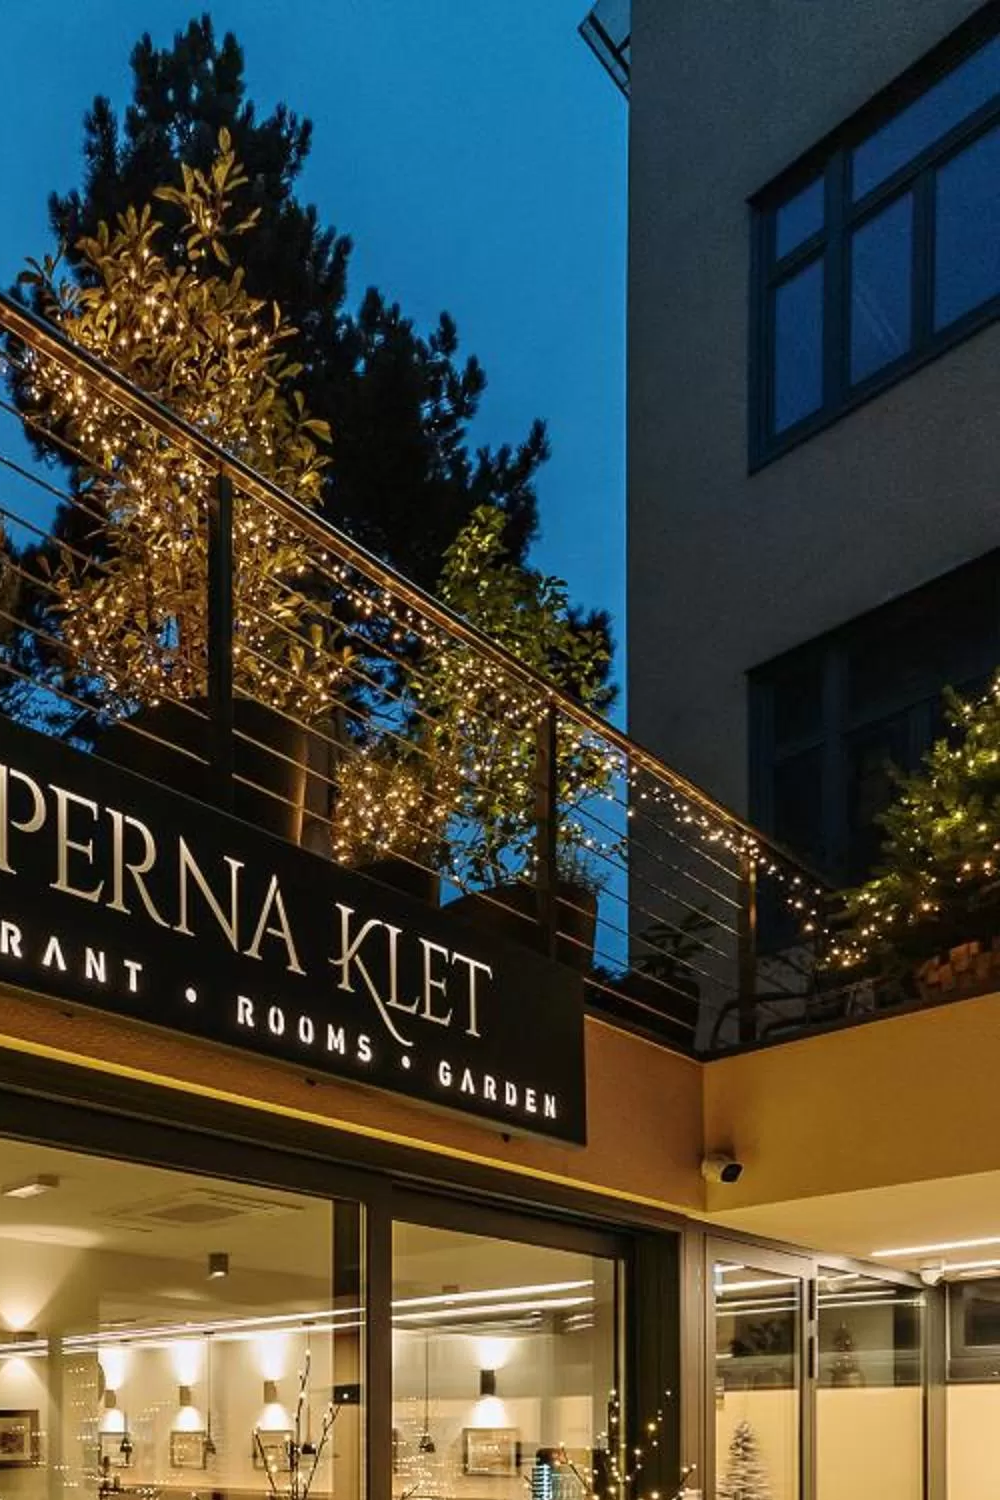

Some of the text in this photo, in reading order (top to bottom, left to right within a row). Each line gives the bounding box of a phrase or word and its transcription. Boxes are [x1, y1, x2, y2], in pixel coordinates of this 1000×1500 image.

[328, 901, 494, 1048] KLET
[236, 994, 374, 1063] ROOMS
[437, 1059, 558, 1120] GARDEN
